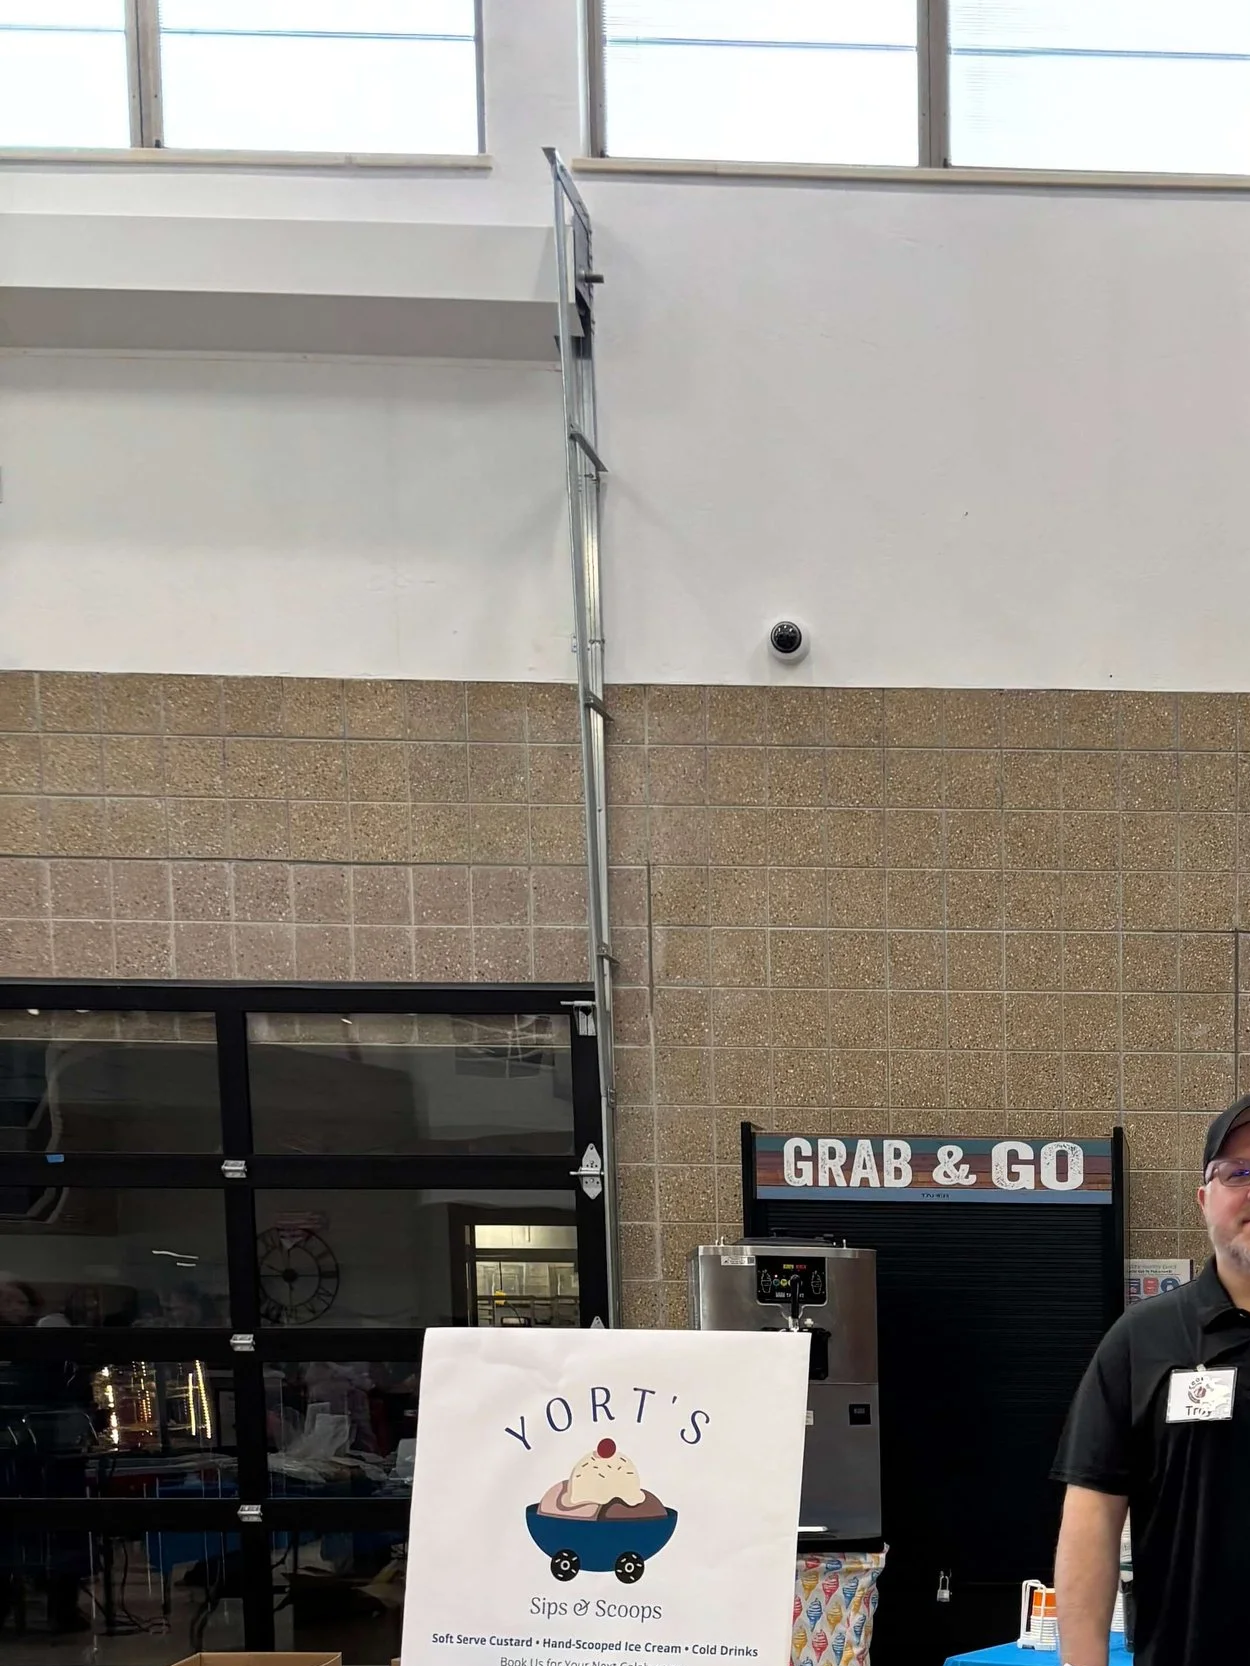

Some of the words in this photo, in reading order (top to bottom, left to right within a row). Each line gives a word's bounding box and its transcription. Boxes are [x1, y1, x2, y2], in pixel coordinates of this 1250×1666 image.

[783, 1137, 913, 1188] GRAB
[931, 1144, 976, 1186] &
[991, 1140, 1084, 1191] GO
[505, 1386, 710, 1452] YORT'S
[530, 1597, 567, 1619] Sips
[574, 1599, 590, 1616] &
[596, 1600, 661, 1623] Scoops
[432, 1634, 453, 1643] Soft
[457, 1635, 486, 1645] Serve
[490, 1636, 532, 1647] Custard
[543, 1638, 621, 1652] Hand-Scooped
[625, 1642, 641, 1652] Ice
[645, 1643, 681, 1653] Cream
[692, 1645, 716, 1654] Cold
[721, 1646, 758, 1657] Drinks
[501, 1657, 527, 1666] Book
